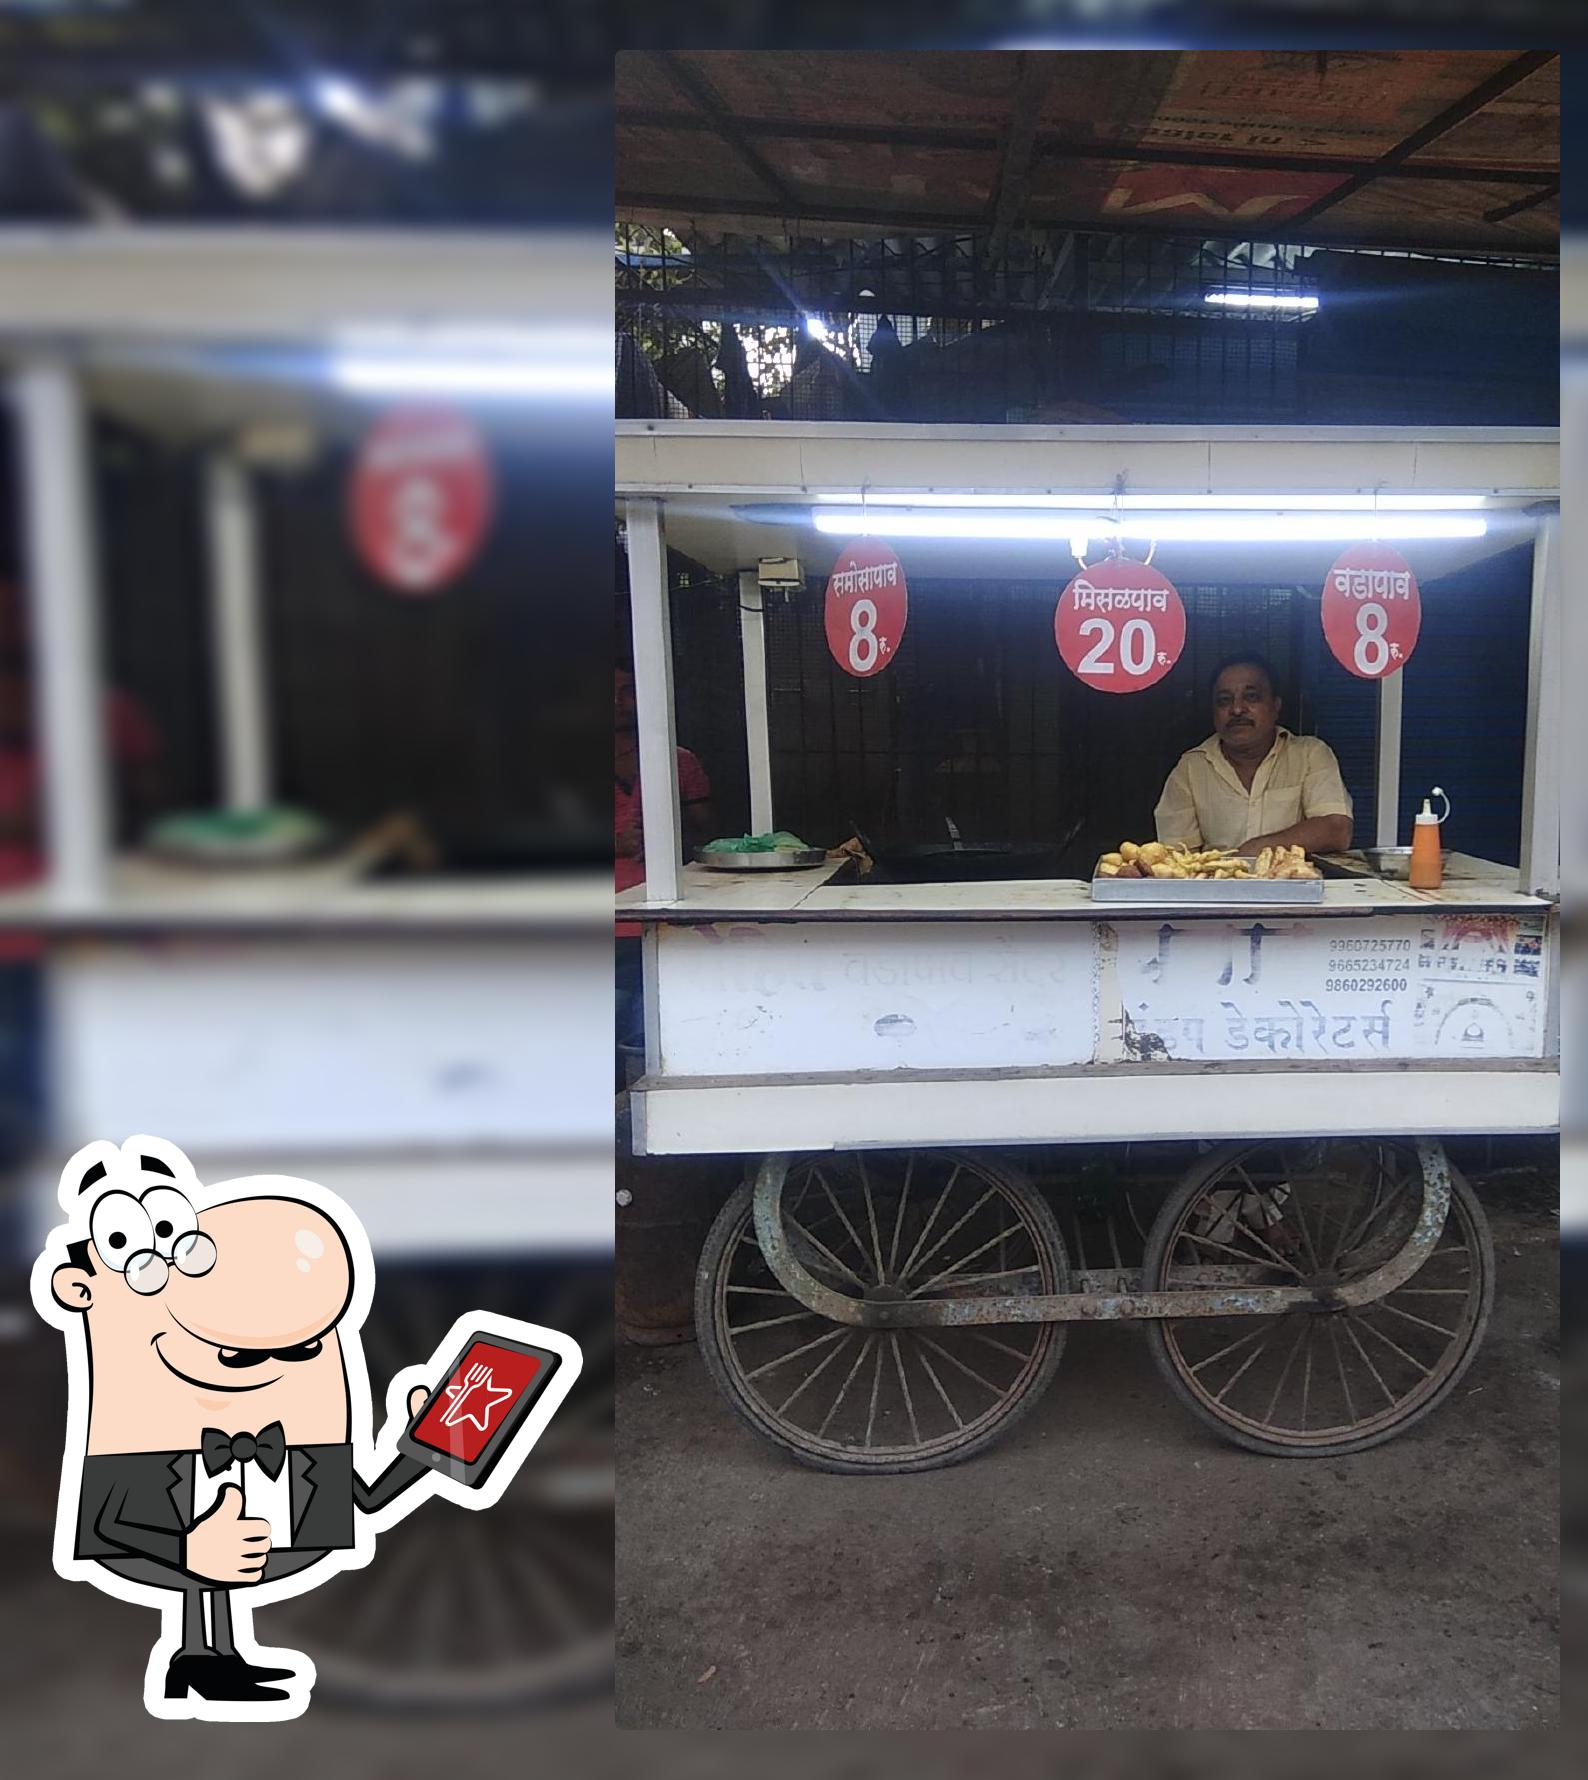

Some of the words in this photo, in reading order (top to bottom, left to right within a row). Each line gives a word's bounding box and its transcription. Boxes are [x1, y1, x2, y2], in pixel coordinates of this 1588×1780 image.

[832, 560, 898, 598] समोसापाव
[1072, 579, 1169, 613] मिसळपाव
[1333, 567, 1411, 600] वडापाव
[849, 599, 878, 672] 8
[1077, 618, 1156, 675] 20
[1354, 602, 1389, 675] 8
[1329, 939, 1411, 952] 9960725770
[1328, 958, 1410, 972] 9665234724
[1325, 978, 1407, 992] 9860292600
[1220, 1000, 1392, 1054] डेकोरेटर्स
